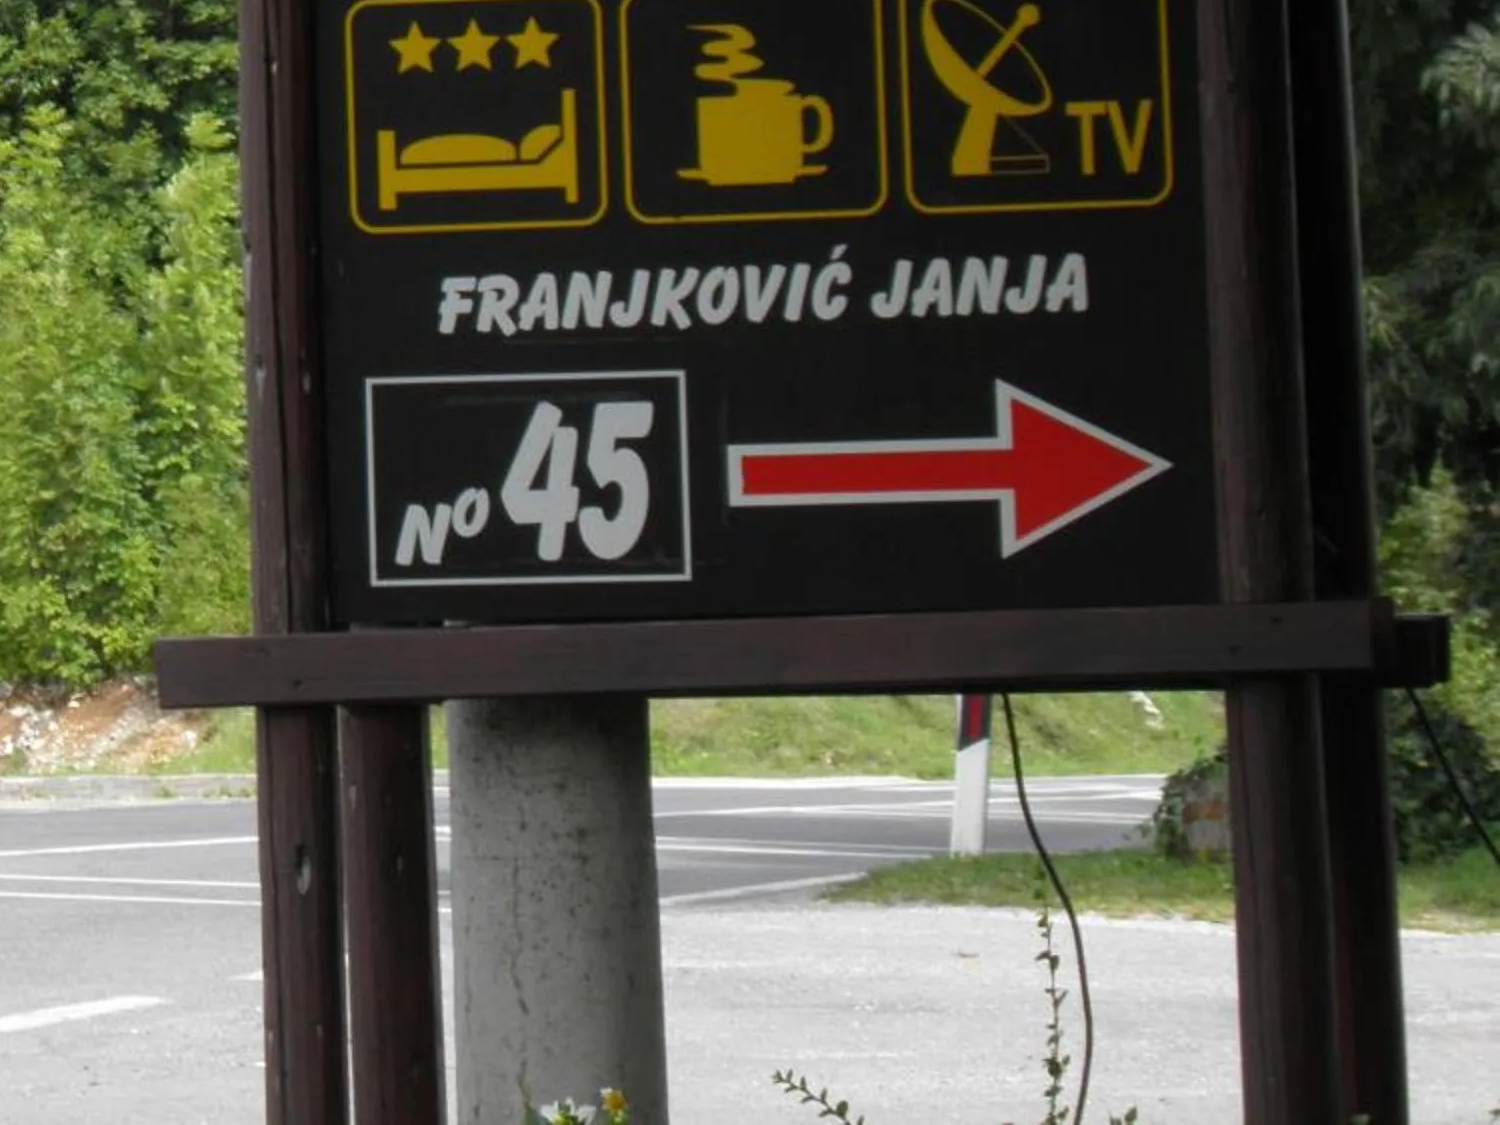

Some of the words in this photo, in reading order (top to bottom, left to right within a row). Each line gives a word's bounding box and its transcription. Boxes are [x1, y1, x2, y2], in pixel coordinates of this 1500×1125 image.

[1065, 99, 1152, 175] TV
[437, 244, 852, 338] FRANJKOVIĆ
[870, 252, 1090, 320] JANJA
[499, 399, 655, 563] 45
